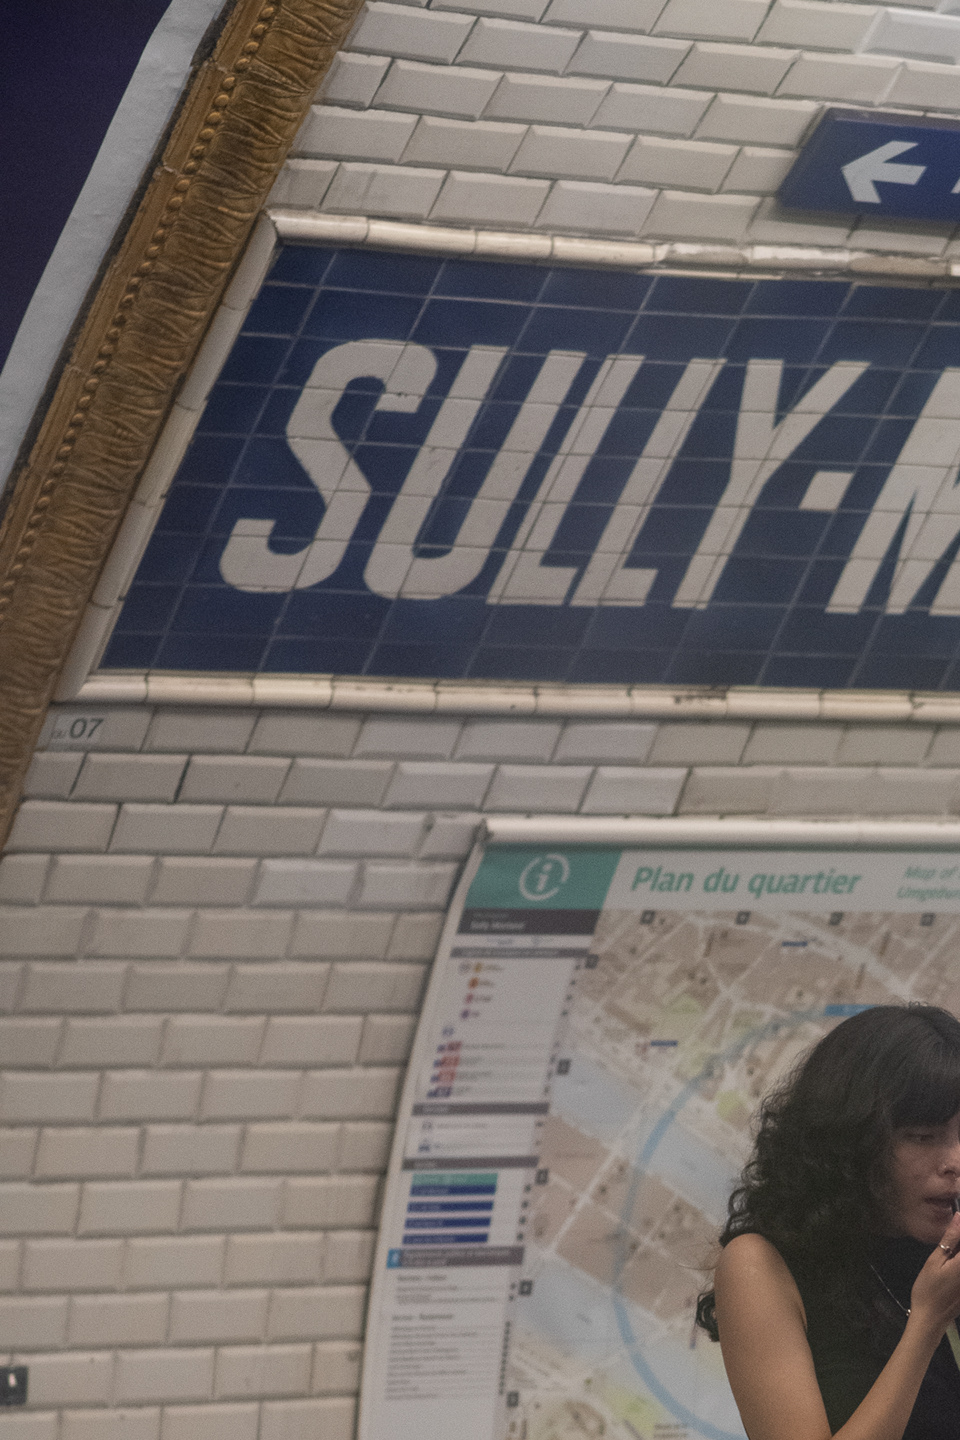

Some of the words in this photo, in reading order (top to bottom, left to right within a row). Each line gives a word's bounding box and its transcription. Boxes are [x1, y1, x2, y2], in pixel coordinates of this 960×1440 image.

[69, 718, 104, 739] 07
[630, 866, 694, 893] Plan
[702, 867, 739, 893] du
[748, 868, 861, 898] quartier
[904, 866, 936, 881] Map
[939, 866, 959, 879] of
